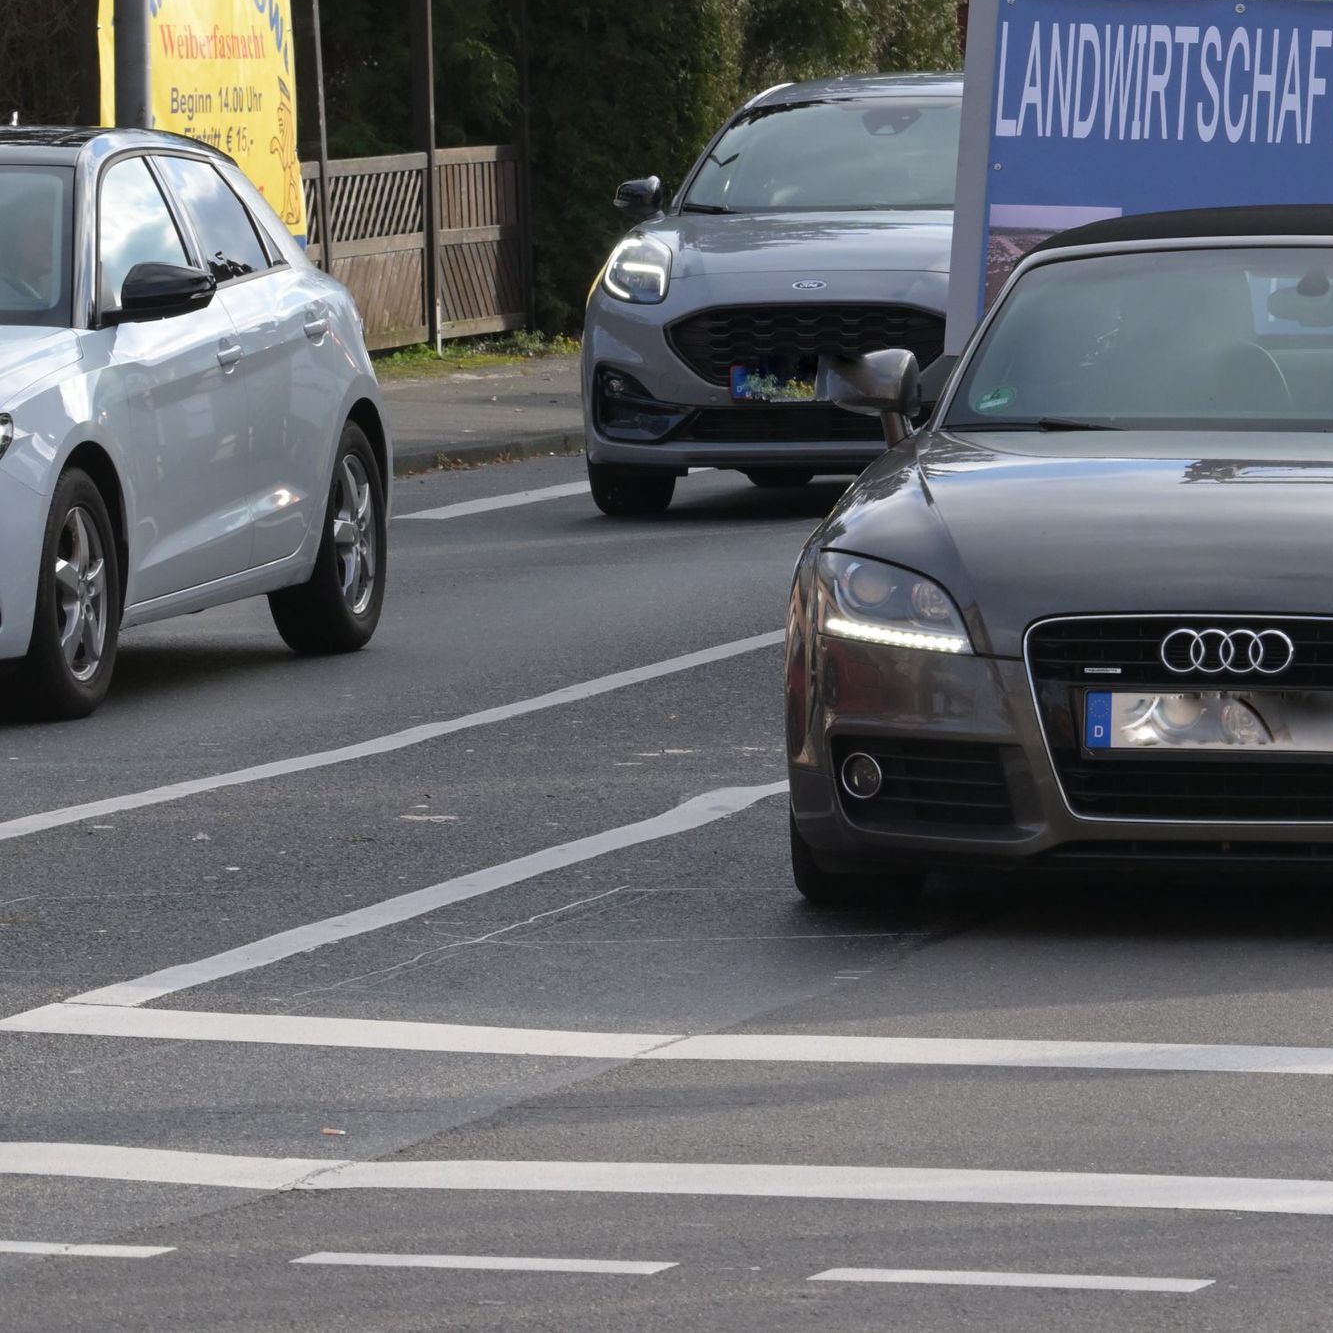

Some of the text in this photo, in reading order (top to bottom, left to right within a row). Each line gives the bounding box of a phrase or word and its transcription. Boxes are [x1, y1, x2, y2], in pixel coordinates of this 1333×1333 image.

[171, 87, 262, 121] Beginn 14.00 Uhr
